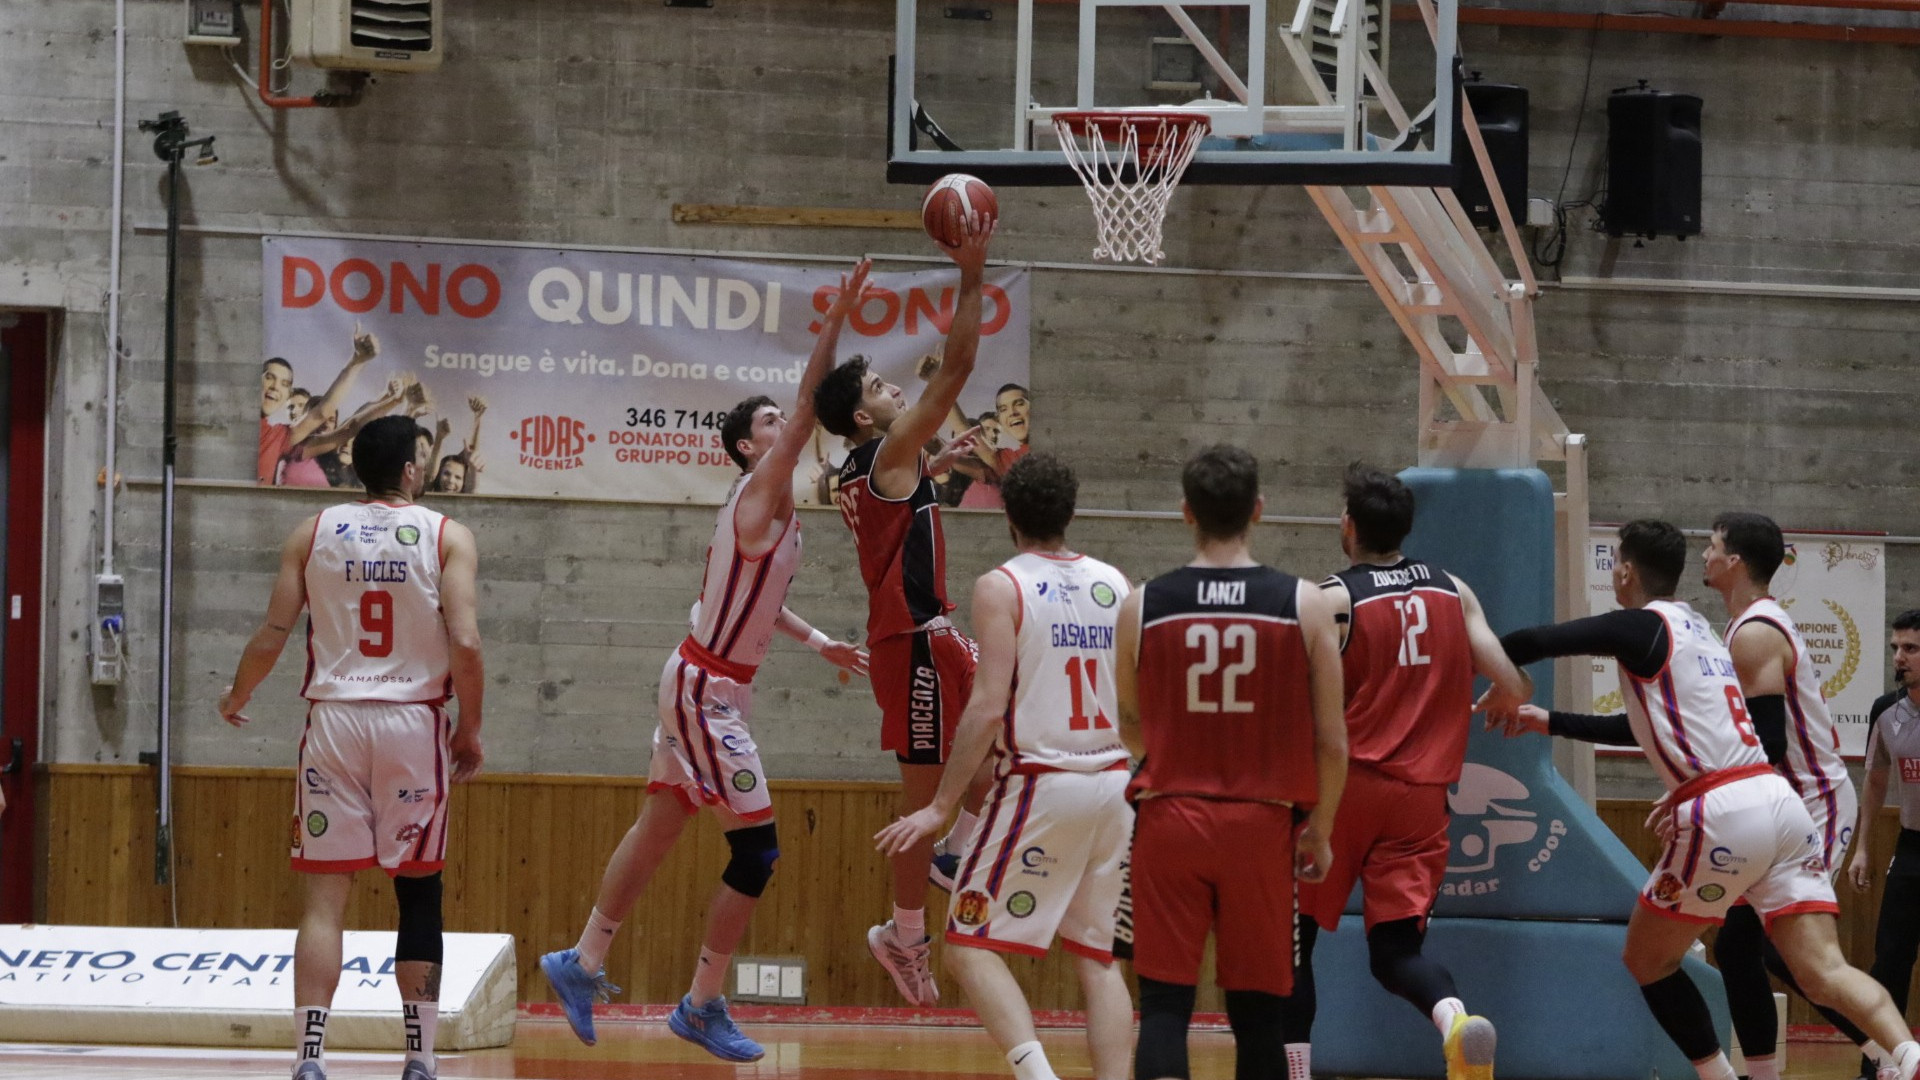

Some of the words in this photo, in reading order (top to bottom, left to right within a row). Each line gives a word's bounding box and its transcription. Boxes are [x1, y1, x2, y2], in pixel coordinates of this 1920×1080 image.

[282, 256, 501, 319] DONO
[528, 267, 781, 333] QUINDI
[808, 284, 1011, 337] SONO
[424, 345, 531, 377] Sangue
[538, 349, 556, 373] è
[562, 350, 625, 377] vita.
[632, 354, 707, 379] Dona
[714, 364, 730, 381] e
[626, 408, 666, 428] 346
[520, 415, 585, 458] FIDAS
[608, 431, 703, 448] DONATORI
[519, 454, 584, 470] VICENZA
[615, 448, 690, 465] GRUPPO
[1197, 580, 1246, 605] LANZI
[359, 590, 394, 658] 9
[1394, 594, 1431, 666] 12
[1795, 623, 1837, 634] MPIONE
[1052, 624, 1114, 650] GASPARIN
[1805, 638, 1844, 650] NCIALE
[333, 674, 413, 684] TRAMAROSSA
[1185, 623, 1257, 713] 22
[1064, 656, 1113, 731] 11
[911, 665, 936, 750] PIACENZA
[1528, 819, 1568, 872] coop
[1440, 877, 1500, 896] adar
[152, 951, 398, 975] CENTAL
